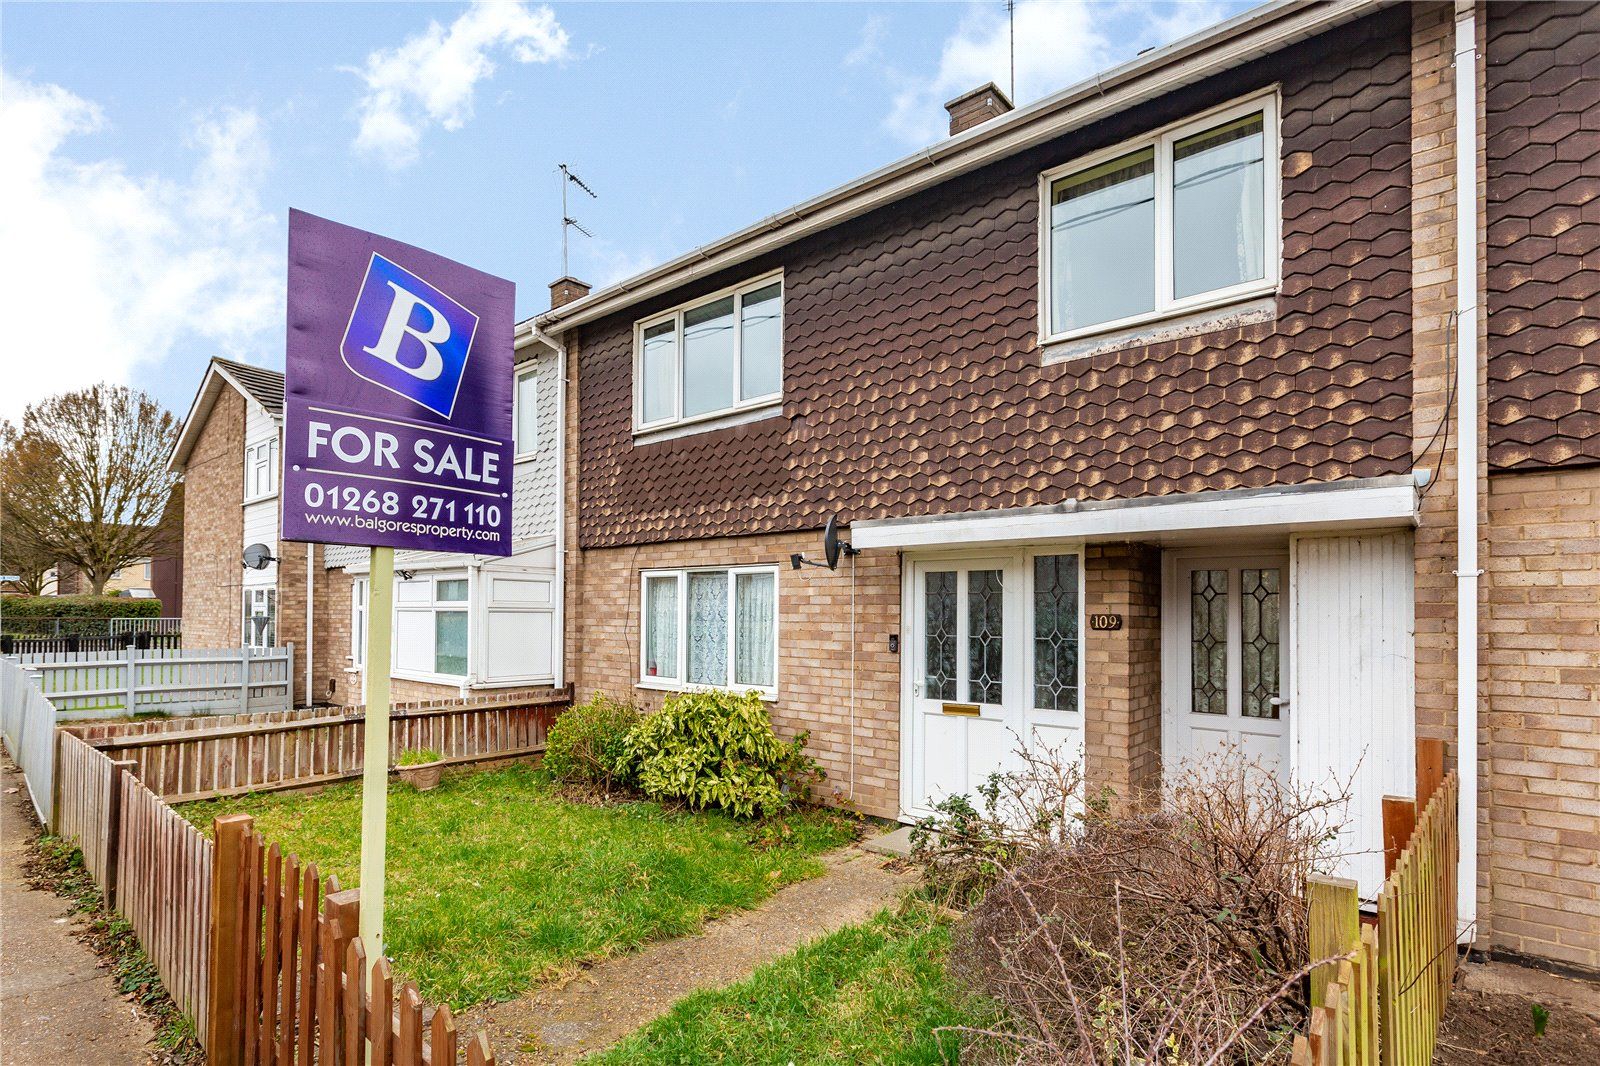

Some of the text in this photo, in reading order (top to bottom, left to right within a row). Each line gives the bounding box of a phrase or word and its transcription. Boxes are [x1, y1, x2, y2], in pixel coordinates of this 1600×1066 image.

[362, 280, 451, 381] B
[307, 420, 500, 485] FOR SALE
[304, 482, 501, 527] 01268 271 110
[304, 512, 501, 542] www.balgoresproperty.com
[1094, 615, 1117, 629] 109
